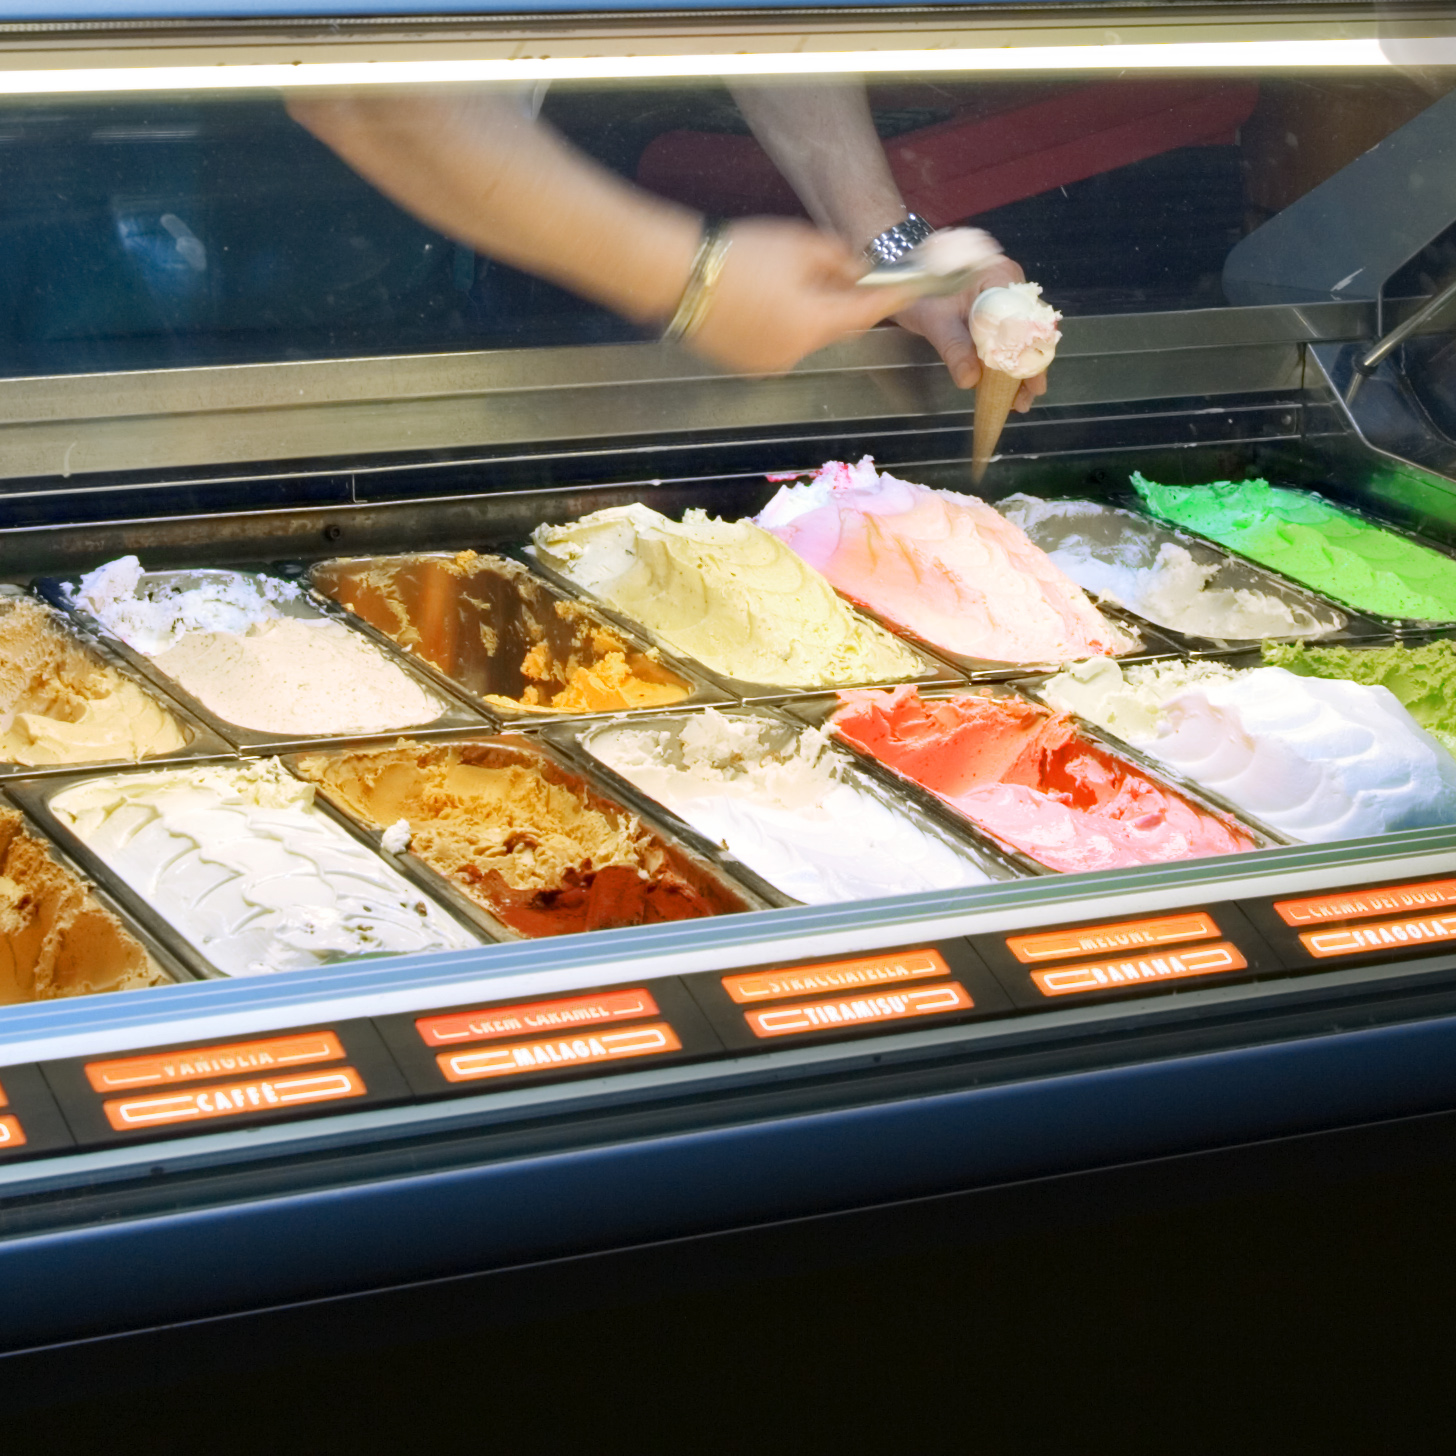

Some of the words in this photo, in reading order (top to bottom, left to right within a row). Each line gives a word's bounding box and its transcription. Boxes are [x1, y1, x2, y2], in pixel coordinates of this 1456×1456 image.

[1352, 920, 1448, 947] FRAGOLA
[1091, 956, 1187, 984] BANANA
[162, 1048, 274, 1077] VANIGLIA
[512, 1038, 606, 1067] MALAGA
[196, 1081, 279, 1112] CAFFÈ
